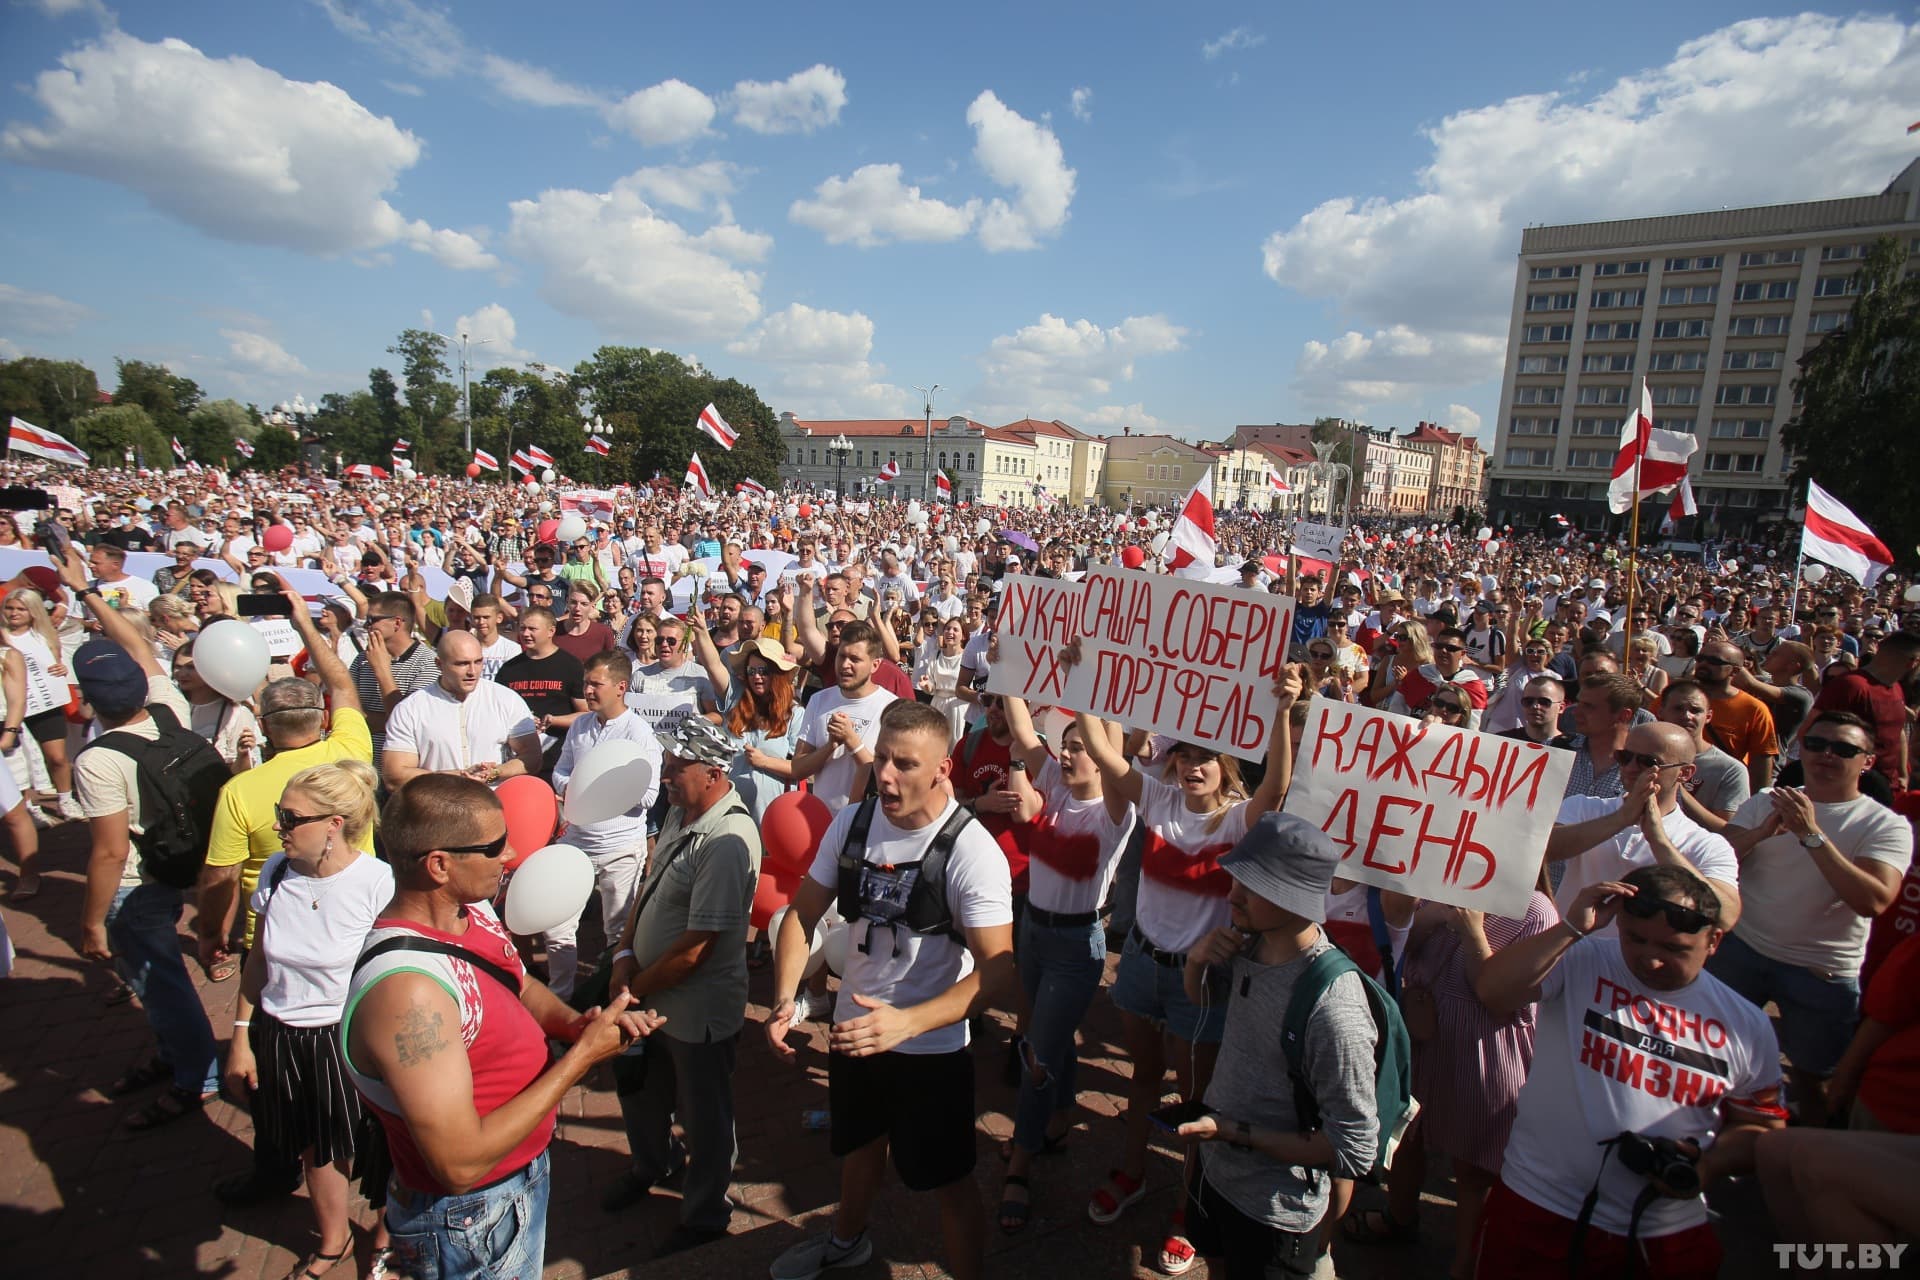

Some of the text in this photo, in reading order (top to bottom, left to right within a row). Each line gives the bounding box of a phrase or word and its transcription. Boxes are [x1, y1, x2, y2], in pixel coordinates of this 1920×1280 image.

[1081, 573, 1291, 680] САША, СОБЕРИ
[530, 680, 562, 690] COUTURE
[631, 707, 689, 718] КАШЕНКО
[1090, 650, 1265, 750] ПОРТФЕЛЬ
[1312, 708, 1550, 812] КАЖДЫЙ
[1321, 788, 1496, 891] ДЕНЬ
[1594, 976, 1727, 1048] ГРОДНО
[1580, 1029, 1726, 1107] ЖИЗНИ
